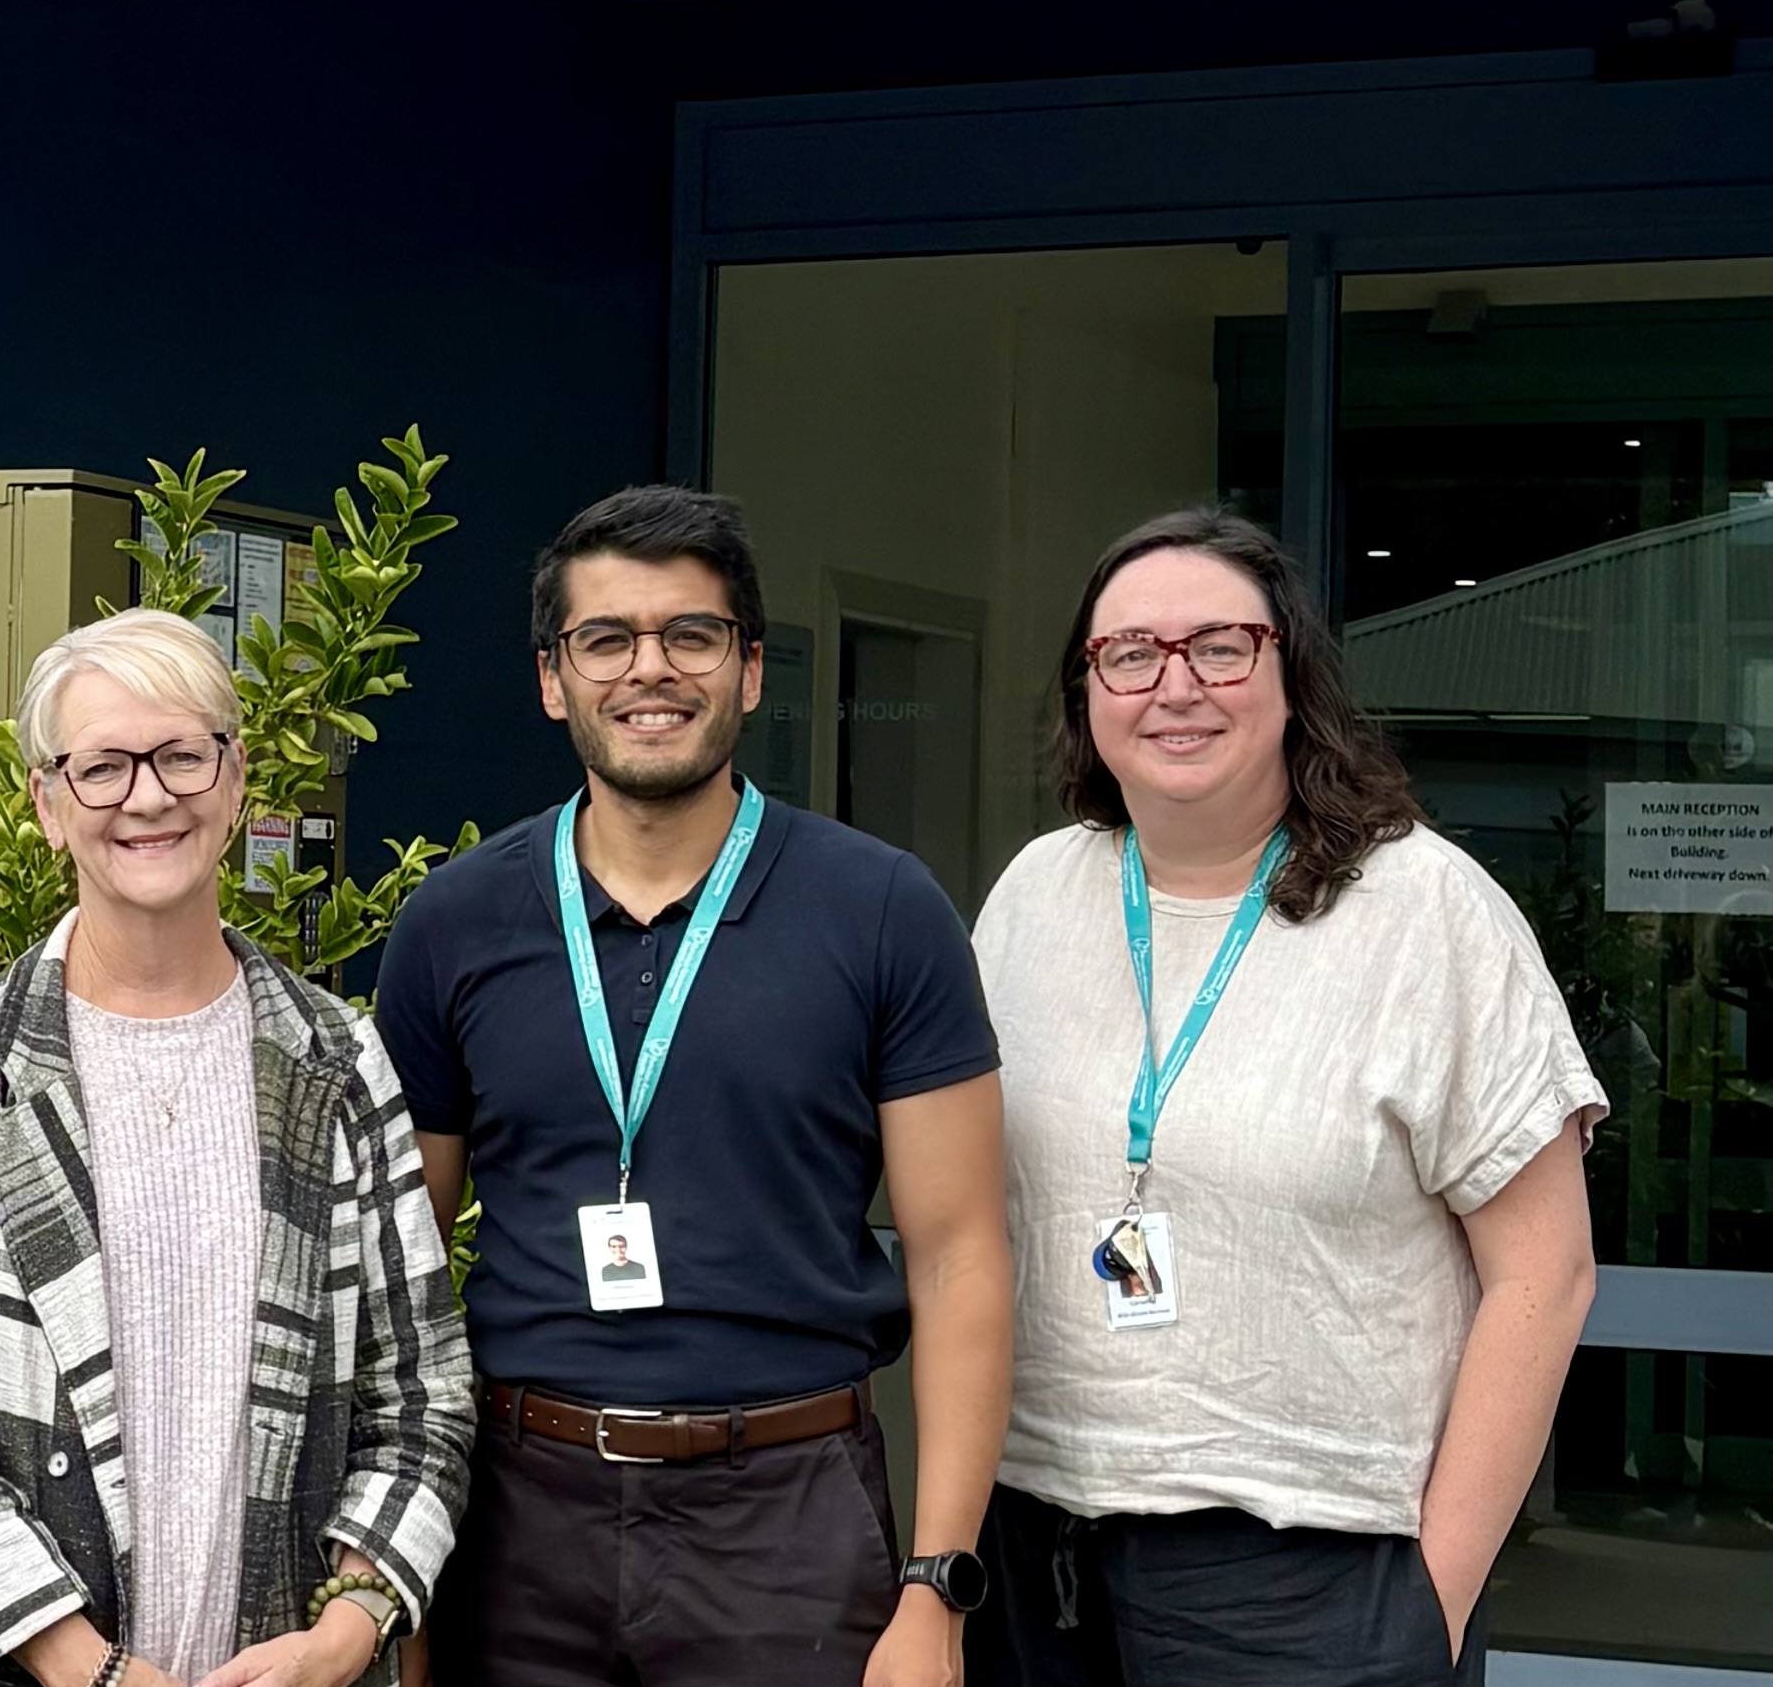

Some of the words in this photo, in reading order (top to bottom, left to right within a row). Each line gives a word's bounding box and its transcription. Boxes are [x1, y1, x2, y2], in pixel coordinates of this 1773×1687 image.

[853, 701, 938, 722] HOURS
[1641, 803, 1680, 814] MAIN
[1684, 803, 1760, 815] RECEPTION
[1640, 827, 1658, 837] on
[1662, 825, 1685, 837] the
[1688, 825, 1725, 837] other
[1729, 825, 1756, 838] side
[1628, 867, 1659, 879] Next
[1663, 867, 1725, 882] driveway
